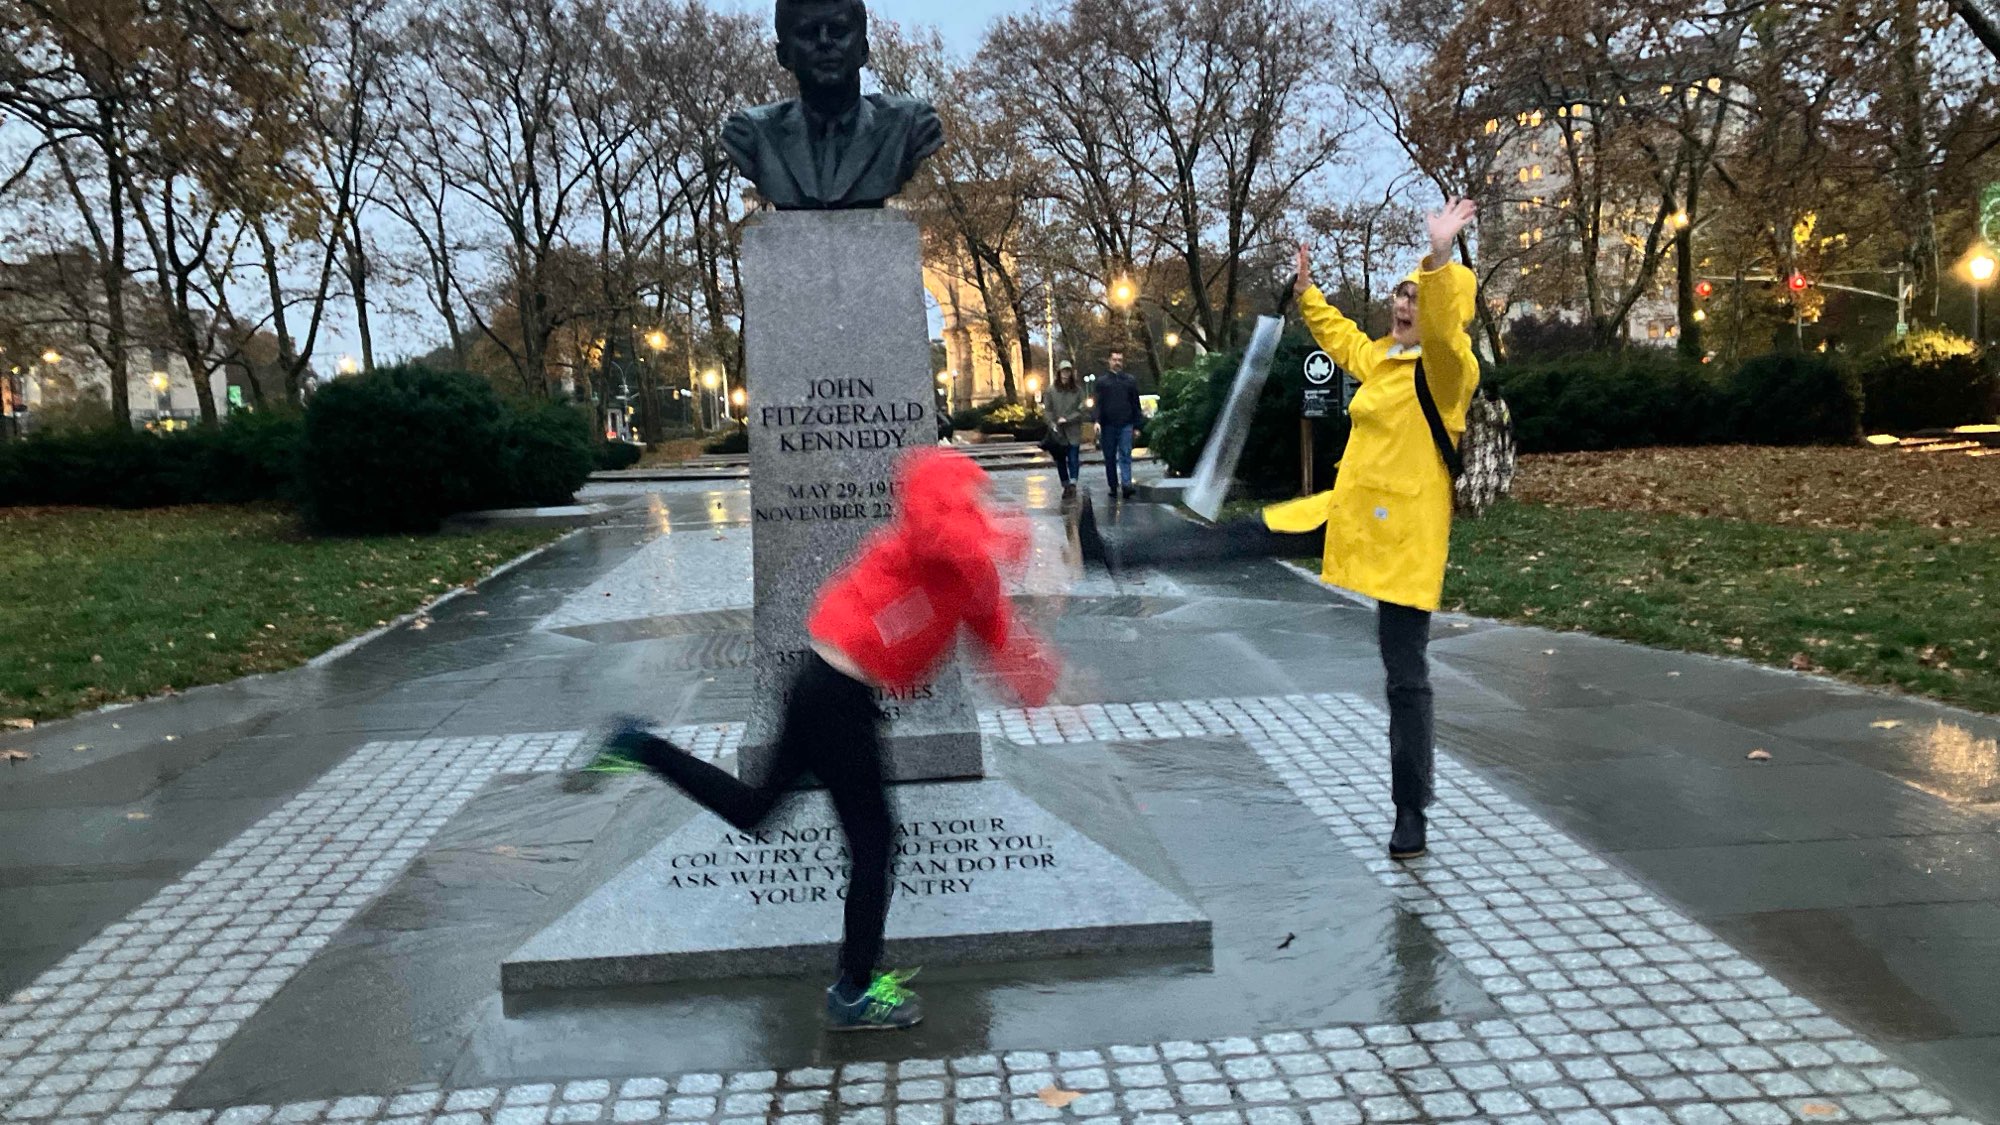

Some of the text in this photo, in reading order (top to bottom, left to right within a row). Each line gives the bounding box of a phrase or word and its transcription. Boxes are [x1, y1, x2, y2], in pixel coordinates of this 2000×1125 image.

[807, 378, 875, 400] JOHN
[762, 402, 924, 427] FITZGERALD
[780, 429, 907, 452] KENNEDY
[788, 483, 831, 499] MAY
[755, 503, 866, 522] NOVEMBER
[721, 830, 771, 846] ASK
[781, 827, 837, 845] NOT
[931, 818, 1006, 835] YOUR
[671, 847, 806, 869] COUNTRY
[814, 846, 850, 862] CA
[929, 838, 979, 855] FOR
[667, 874, 720, 889] ASK
[730, 866, 817, 885] WHAT
[891, 859, 948, 876] CAN
[957, 856, 996, 873] DO
[1004, 853, 1058, 870] FOR
[749, 886, 828, 905] YOUR
